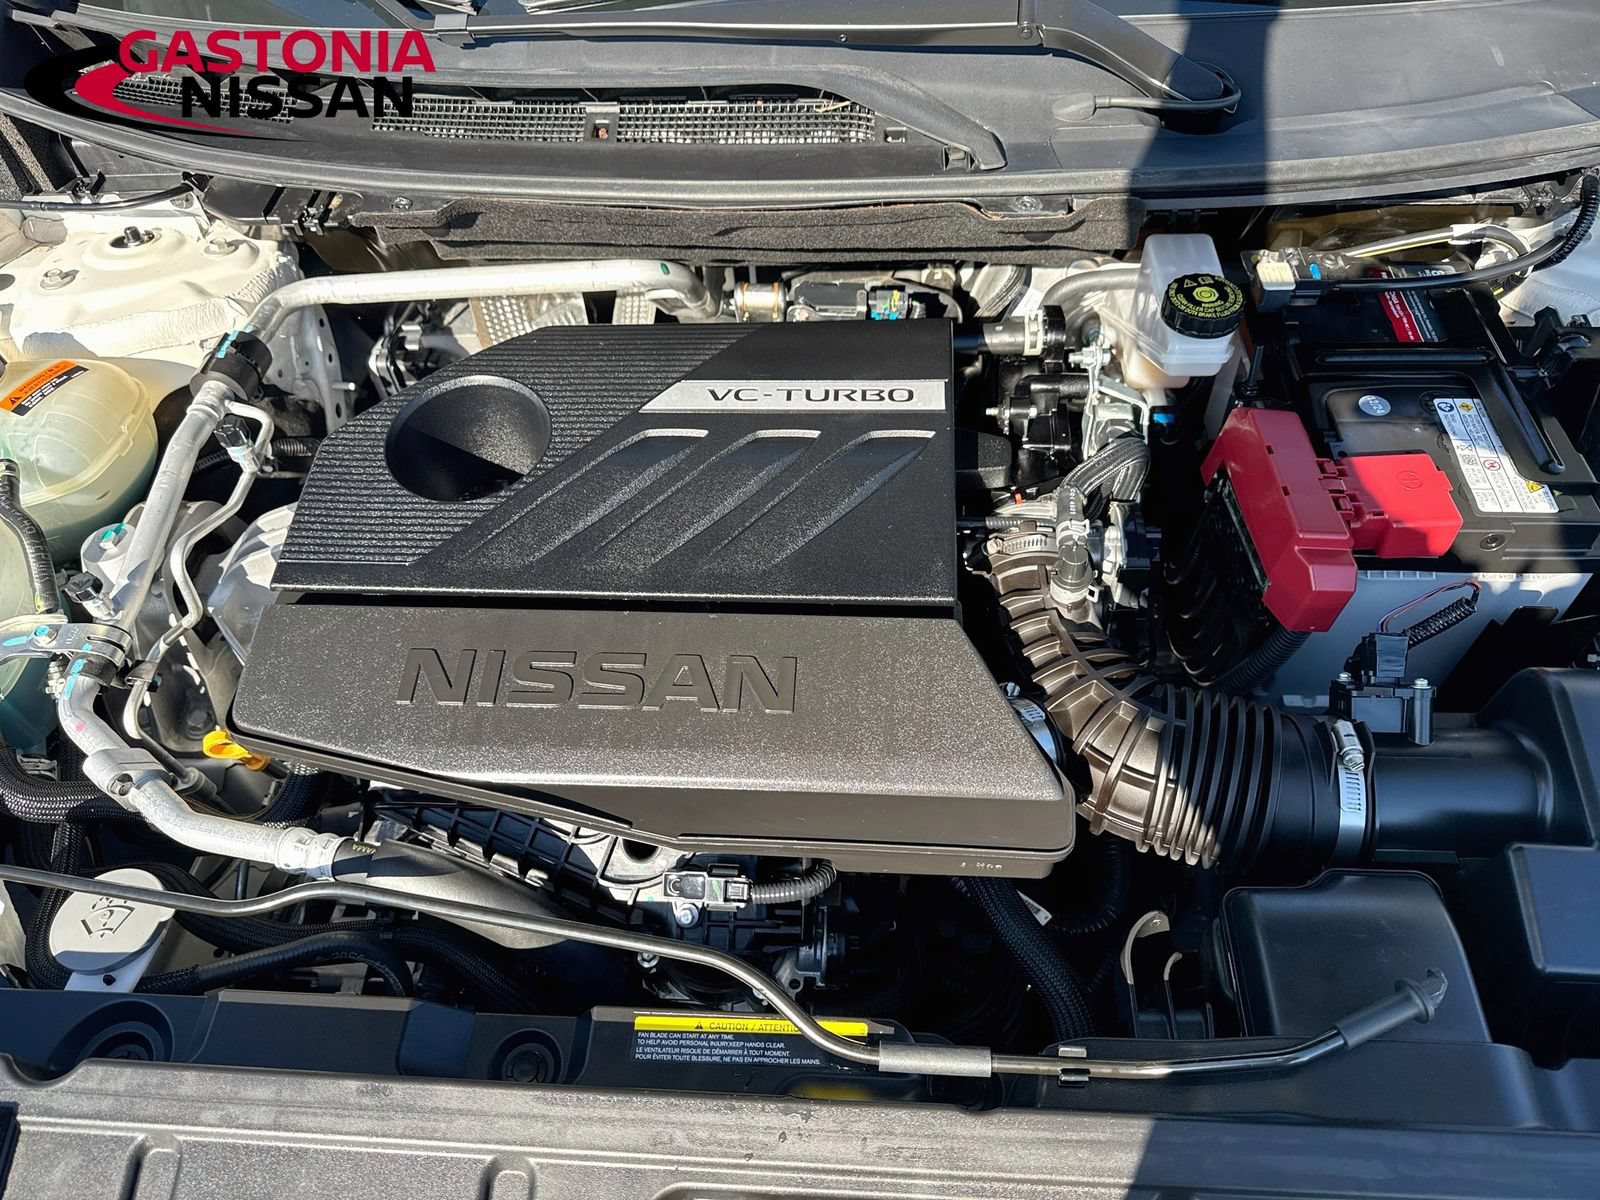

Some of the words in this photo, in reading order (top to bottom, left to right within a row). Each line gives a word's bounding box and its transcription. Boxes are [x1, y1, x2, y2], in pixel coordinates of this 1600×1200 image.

[707, 388, 914, 402] VC-TURBO
[396, 647, 797, 714] NISSAN
[709, 1022, 748, 1031] CAUTION
